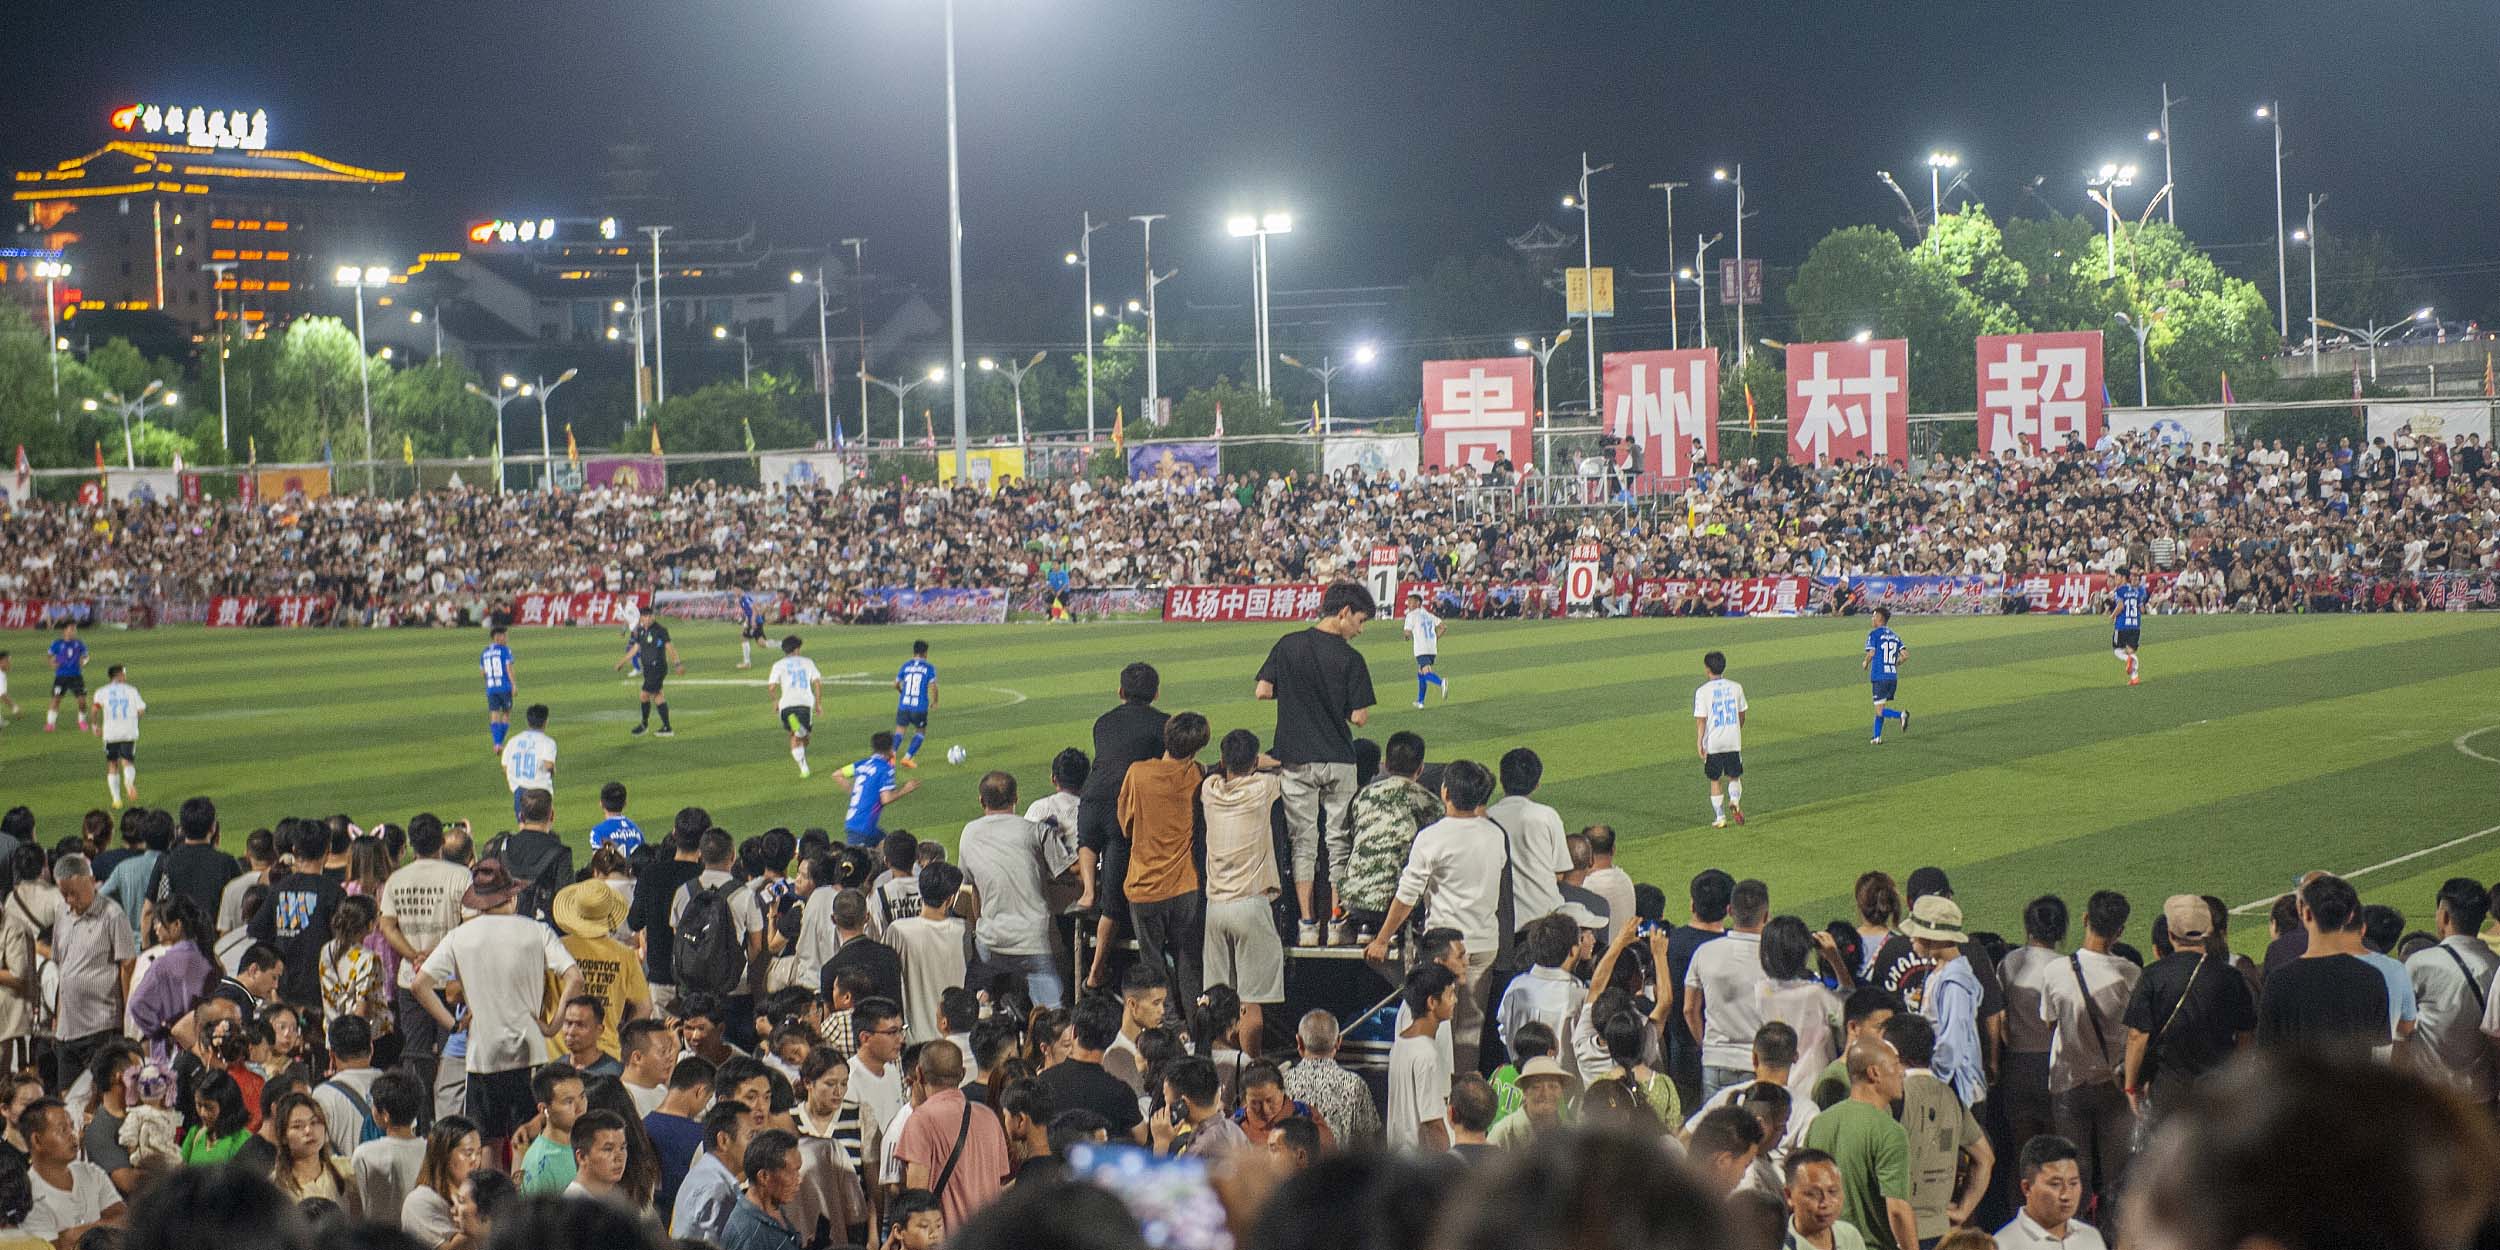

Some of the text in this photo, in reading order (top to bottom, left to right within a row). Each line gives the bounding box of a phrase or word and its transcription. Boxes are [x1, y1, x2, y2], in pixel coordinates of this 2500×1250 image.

[1431, 343, 2088, 477] 贵 州 村 超
[1374, 570, 1388, 601] 1
[1572, 566, 1593, 599] 0
[1171, 586, 1322, 618] 弘扬中国精神
[2124, 598, 2138, 617] 13
[1880, 641, 1897, 664] 12
[904, 673, 922, 697] 18
[109, 698, 129, 720] 77
[1711, 698, 1737, 727] 55
[512, 751, 536, 779] 19
[576, 959, 621, 974] OODSTOCK
[1884, 951, 1938, 993] CHAL
